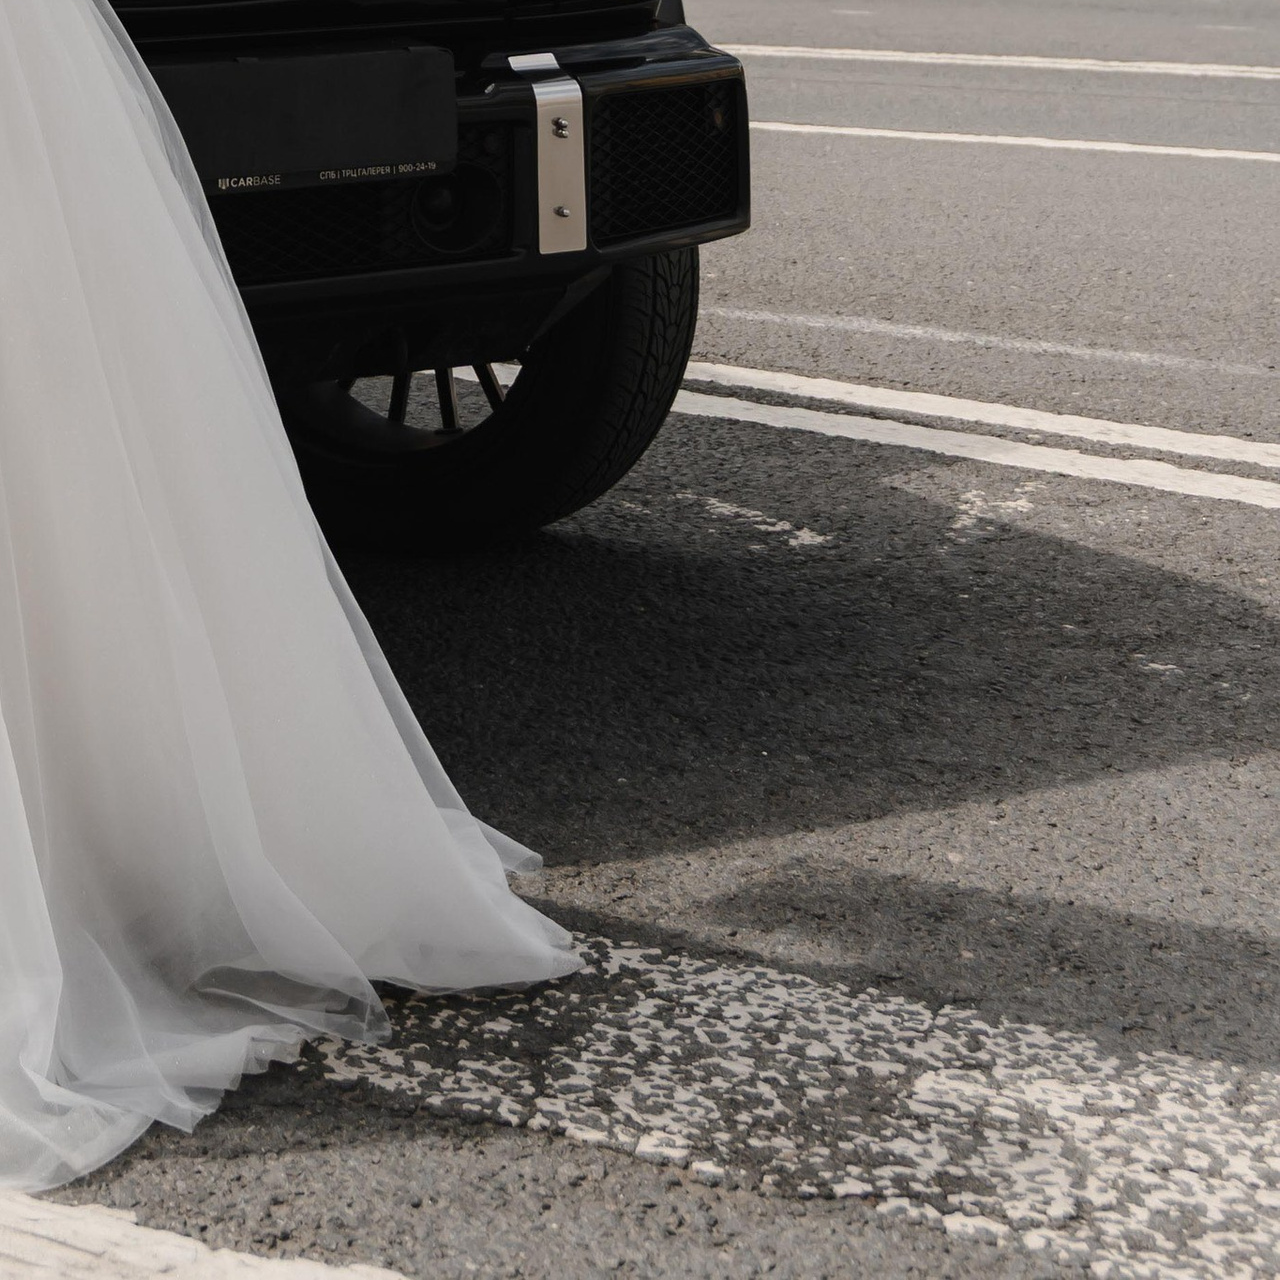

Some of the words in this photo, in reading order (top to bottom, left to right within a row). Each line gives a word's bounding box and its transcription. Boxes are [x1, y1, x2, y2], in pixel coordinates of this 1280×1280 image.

[320, 171, 336, 180] СПБ
[342, 168, 357, 178] ТРЦ
[358, 165, 391, 176] ГАЛЕРЕЯ
[230, 174, 281, 188] CARBASE
